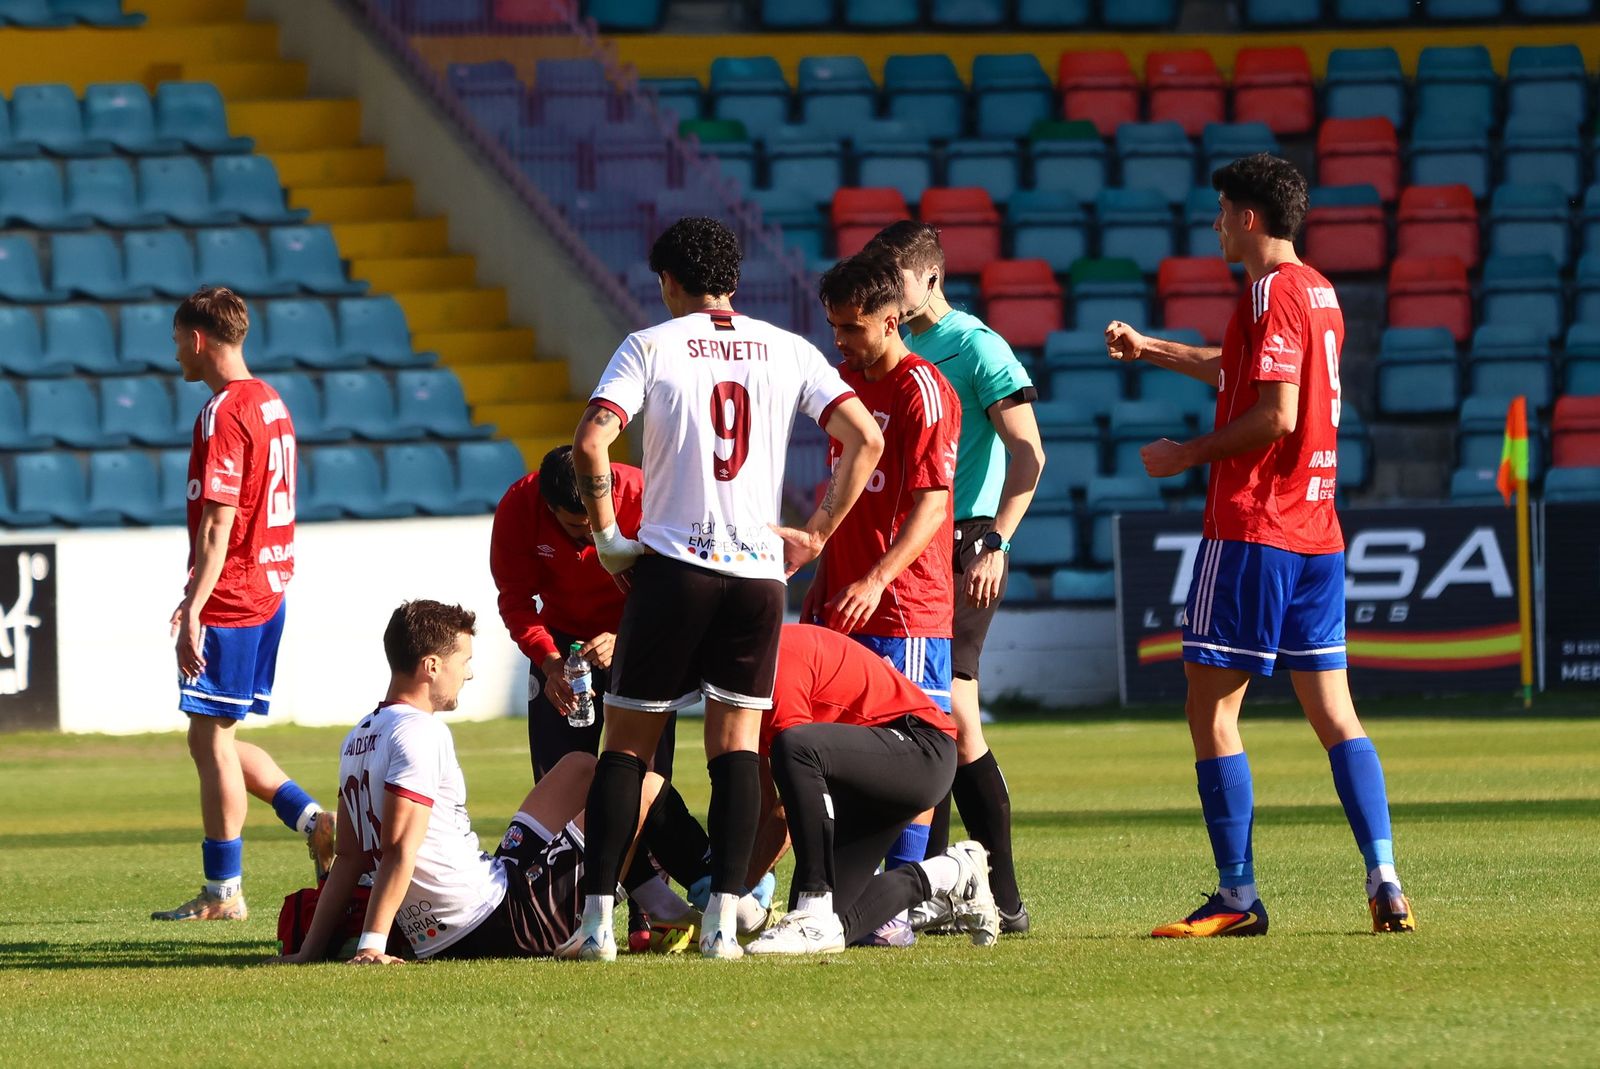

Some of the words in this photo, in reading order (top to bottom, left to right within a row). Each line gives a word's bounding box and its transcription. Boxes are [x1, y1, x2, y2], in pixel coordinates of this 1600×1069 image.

[687, 338, 768, 361] SERVETTI
[1324, 329, 1341, 428] 9
[710, 380, 751, 482] 9
[1310, 450, 1337, 468] ABA
[267, 434, 296, 528] 20
[259, 542, 295, 564] ABA
